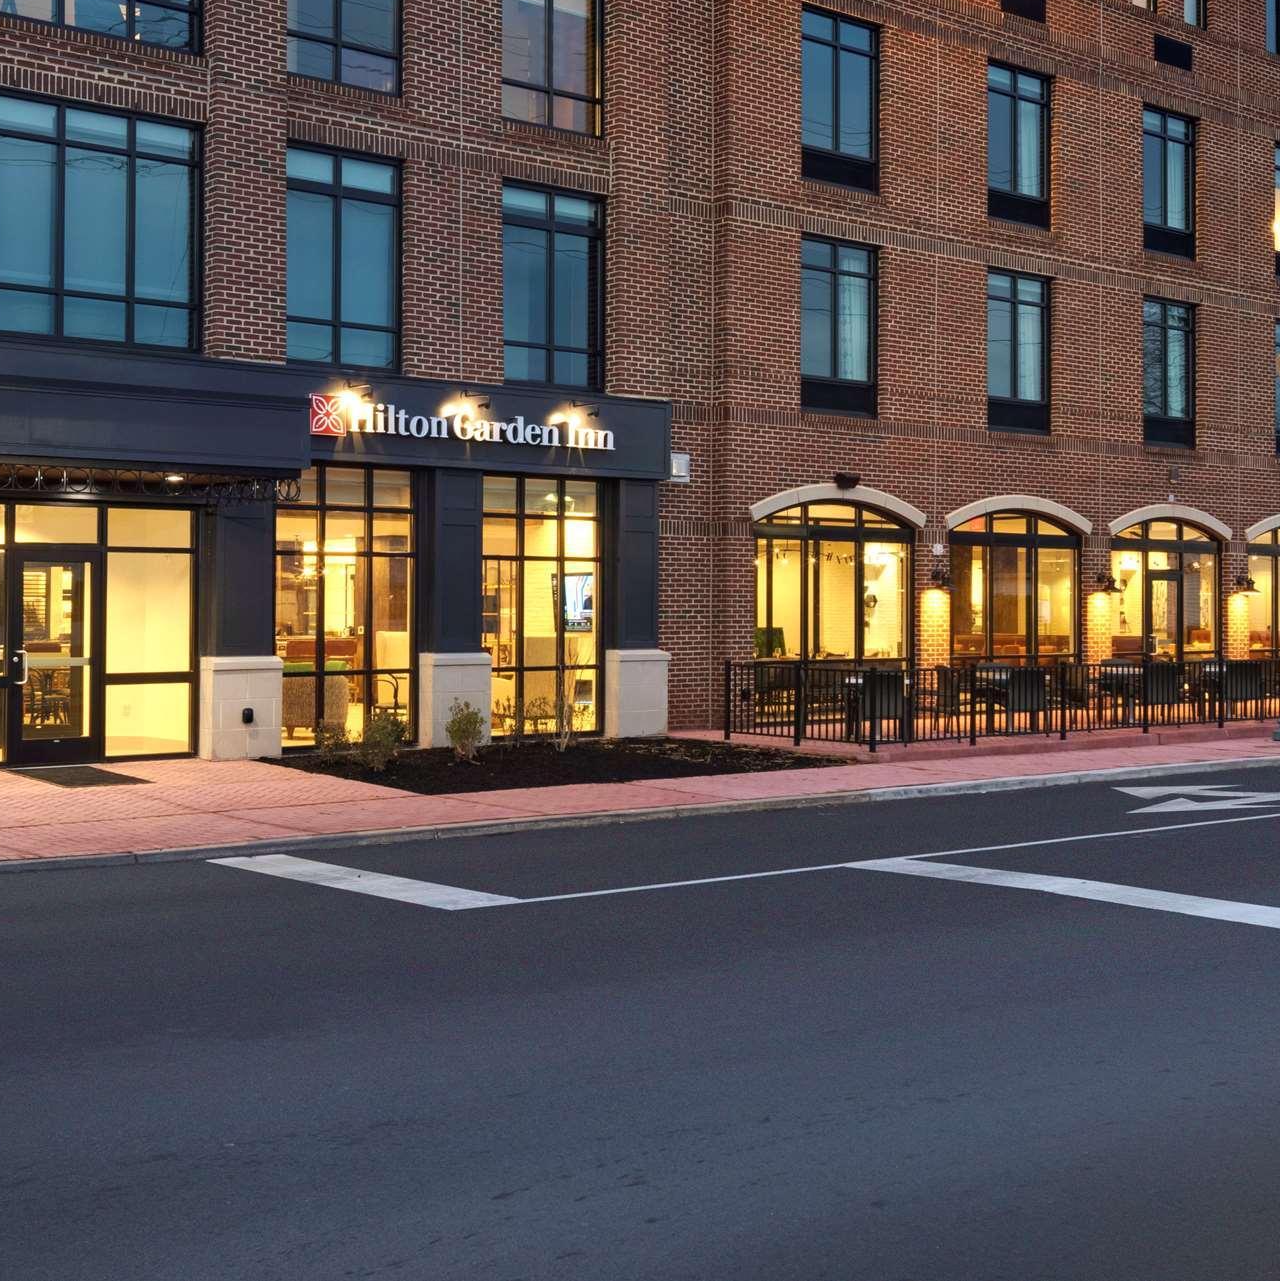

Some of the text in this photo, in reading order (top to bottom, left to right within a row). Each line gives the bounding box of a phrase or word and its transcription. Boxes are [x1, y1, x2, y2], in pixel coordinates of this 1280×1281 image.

[351, 403, 616, 451] Hilton Garden Inn
